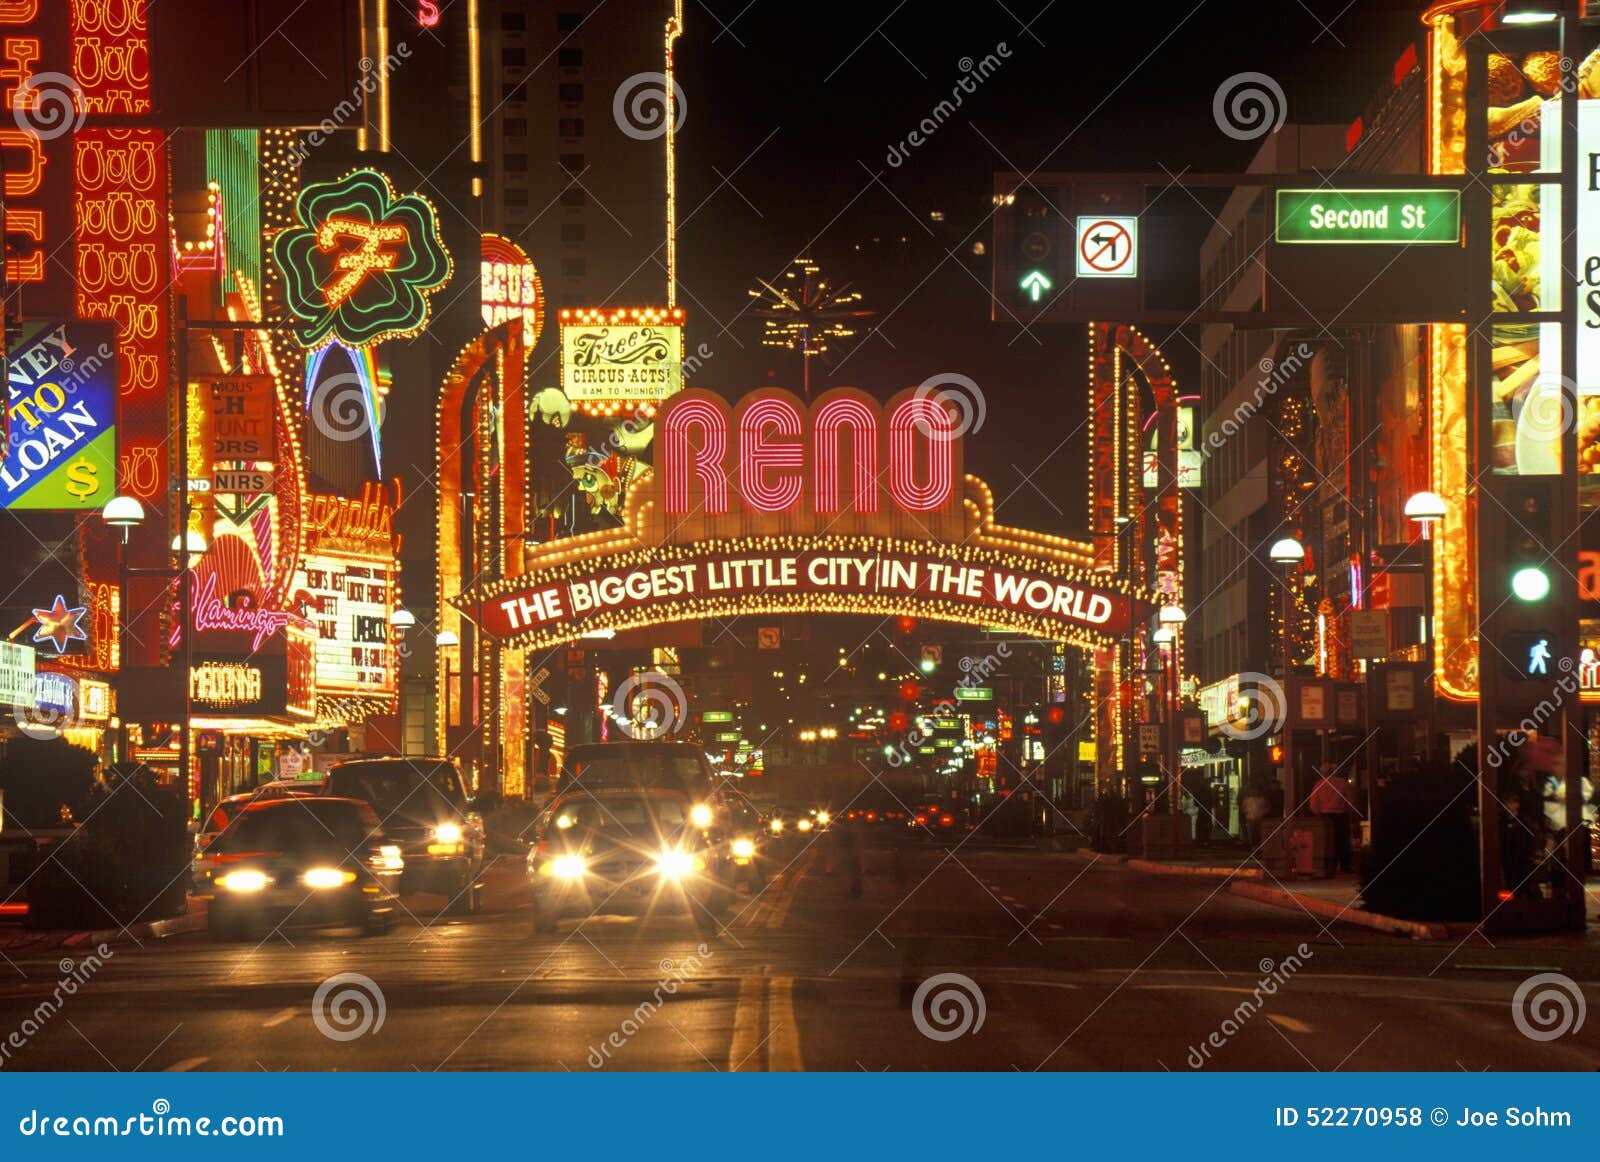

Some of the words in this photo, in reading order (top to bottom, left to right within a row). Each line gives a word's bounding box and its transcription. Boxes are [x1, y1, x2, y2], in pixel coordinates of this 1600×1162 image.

[1308, 203, 1388, 229] Second
[1400, 203, 1425, 229] St
[573, 368, 624, 384] CIRCUS
[630, 367, 671, 385] ACTS!
[590, 387, 603, 395] AM
[608, 387, 620, 395] TO
[624, 387, 665, 395] MIDNIGHT
[9, 382, 66, 430] TO
[0, 400, 98, 492] LOAN
[664, 397, 953, 514] RENO
[501, 589, 563, 629] THE
[571, 564, 697, 612] BIGGEST
[707, 558, 797, 591] LITTLE
[807, 558, 875, 587] CITY
[881, 561, 917, 590] IN
[927, 563, 985, 598] THE
[993, 573, 1112, 624] WORLD
